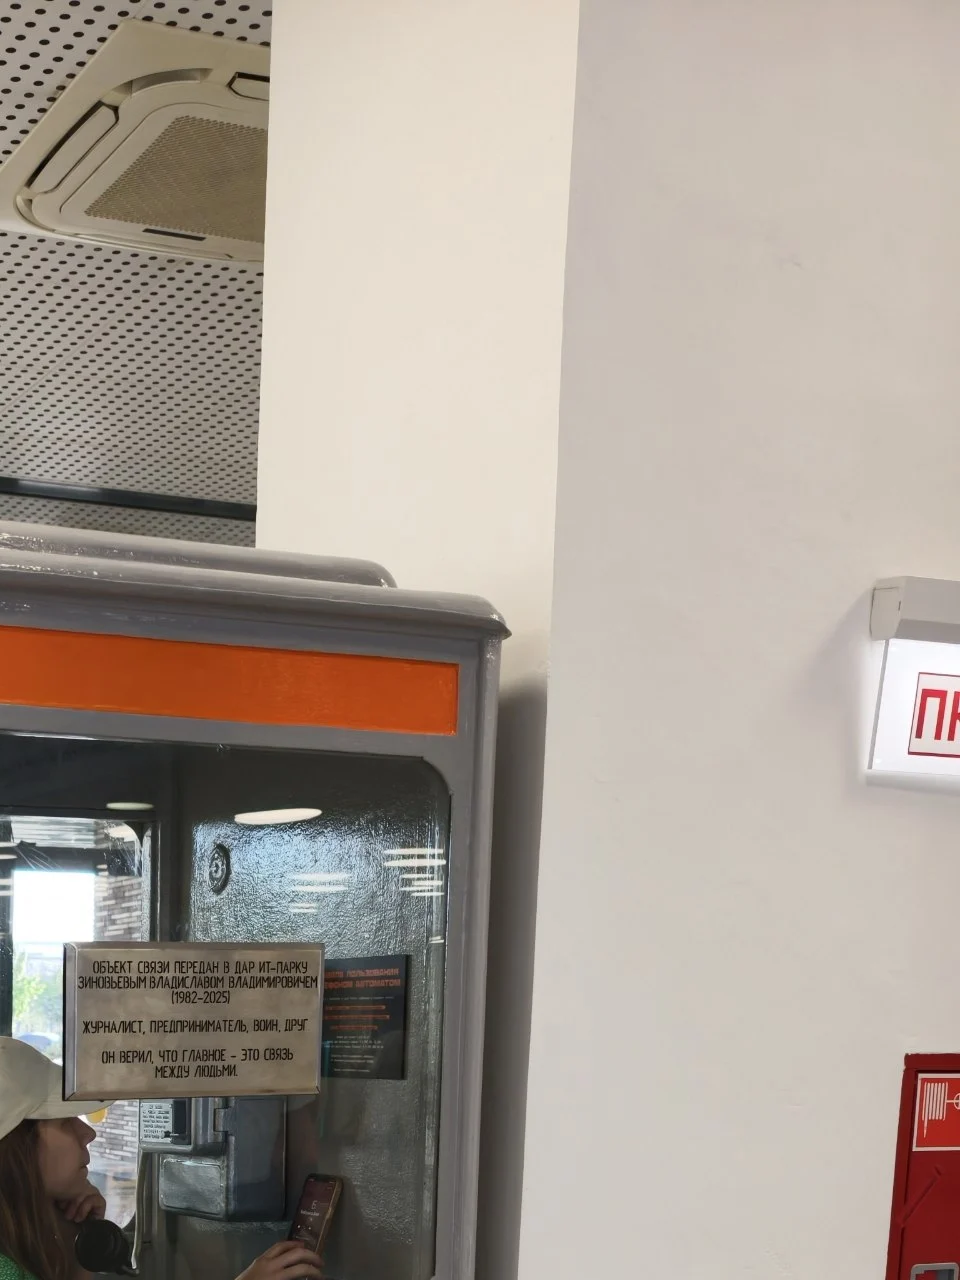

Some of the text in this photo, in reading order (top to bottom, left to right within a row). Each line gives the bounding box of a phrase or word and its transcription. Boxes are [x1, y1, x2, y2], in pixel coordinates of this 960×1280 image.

[92, 960, 308, 974] ОБЪЕКТ СВЯЗИ ПЕРЕДАН В ДАР ИТ-ПАРКУ
[78, 976, 318, 989] ЗИНОВЬЕВЫМ ВЛАДИСЛАВОМ ВЛАДИМИРОВИЧЕМ
[82, 1018, 308, 1035] ЖУРНАЛИСТ, ПРЕДПРИНИМАТЕЛЬ, ВОИН, ДРУГ
[101, 1050, 115, 1064] ОН
[119, 1050, 154, 1064] ВЕРИЛ,
[159, 1049, 178, 1062] ЧТО
[182, 1049, 226, 1062] ГЛАВНОЕ
[240, 1048, 259, 1061] ЭТО
[263, 1048, 294, 1061] СВЯЗЬ
[155, 1064, 239, 1078] МЕЖДУ ЛЮДЬМИ.
